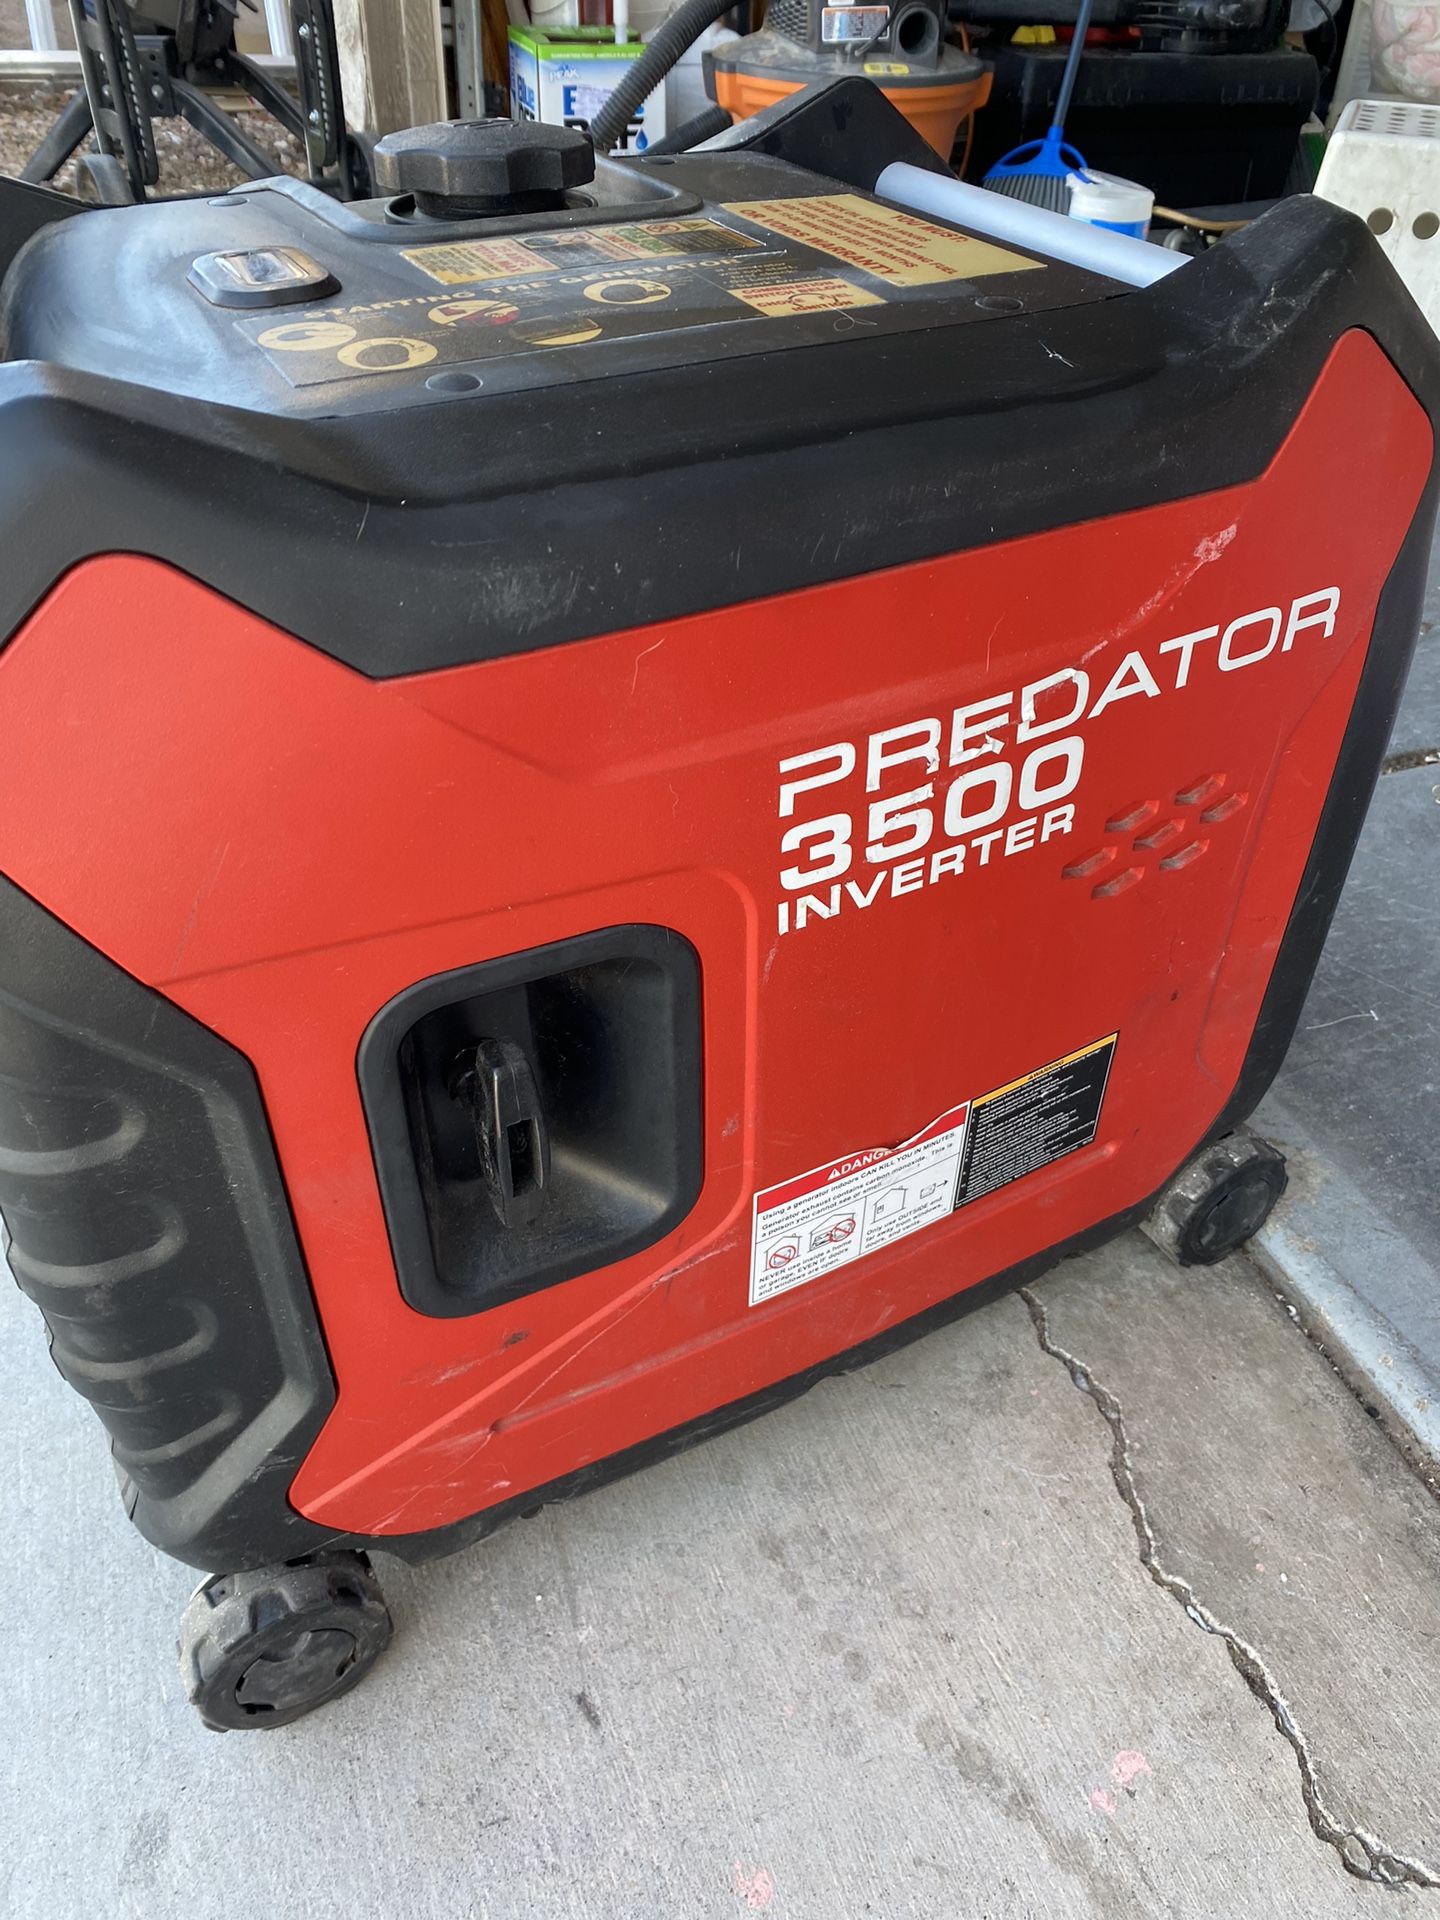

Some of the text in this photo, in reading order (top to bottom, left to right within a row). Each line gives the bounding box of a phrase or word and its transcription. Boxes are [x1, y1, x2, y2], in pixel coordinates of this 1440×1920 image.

[892, 215, 925, 225] YOU
[740, 210, 766, 218] OR
[763, 219, 809, 237] VOIDS
[807, 238, 898, 274] WARRANTY
[875, 250, 917, 267] MONTHS
[930, 262, 957, 274] FUEL
[303, 291, 475, 319] STARTING
[483, 281, 552, 294] THE
[560, 258, 742, 285] GENERATOR
[743, 281, 832, 294] COMBINATION
[792, 301, 853, 311] IGNITION
[779, 586, 1341, 818] PREDATOR
[780, 736, 1085, 891] 3500
[777, 803, 1075, 936] INVERTER
[841, 1151, 893, 1175] DANG
[762, 1208, 784, 1220] Using
[793, 1189, 828, 1208] generator
[831, 1177, 858, 1191] indoors
[861, 1168, 877, 1178] CAN
[879, 1161, 894, 1170] KILL
[897, 1152, 912, 1162] YOU
[762, 1212, 799, 1230] Generator
[802, 1197, 831, 1213] exhaust
[833, 1184, 863, 1200] contains
[865, 1172, 889, 1185] carbon
[931, 1147, 944, 1155] This
[768, 1221, 794, 1235] poison
[796, 1214, 809, 1224] you
[812, 1202, 836, 1216] cannot
[839, 1196, 851, 1204] see
[866, 1196, 942, 1235] Only use OUTSIDE and
[877, 1227, 893, 1237] away
[895, 1218, 911, 1228] from
[888, 1228, 900, 1237] and
[759, 1268, 785, 1282] NEVER
[787, 1262, 800, 1271] use
[802, 1252, 824, 1264] inside
[832, 1240, 851, 1251] home
[797, 1261, 817, 1273] EVEN
[828, 1248, 848, 1259] doors
[758, 1287, 772, 1296] and
[774, 1273, 805, 1289] windows
